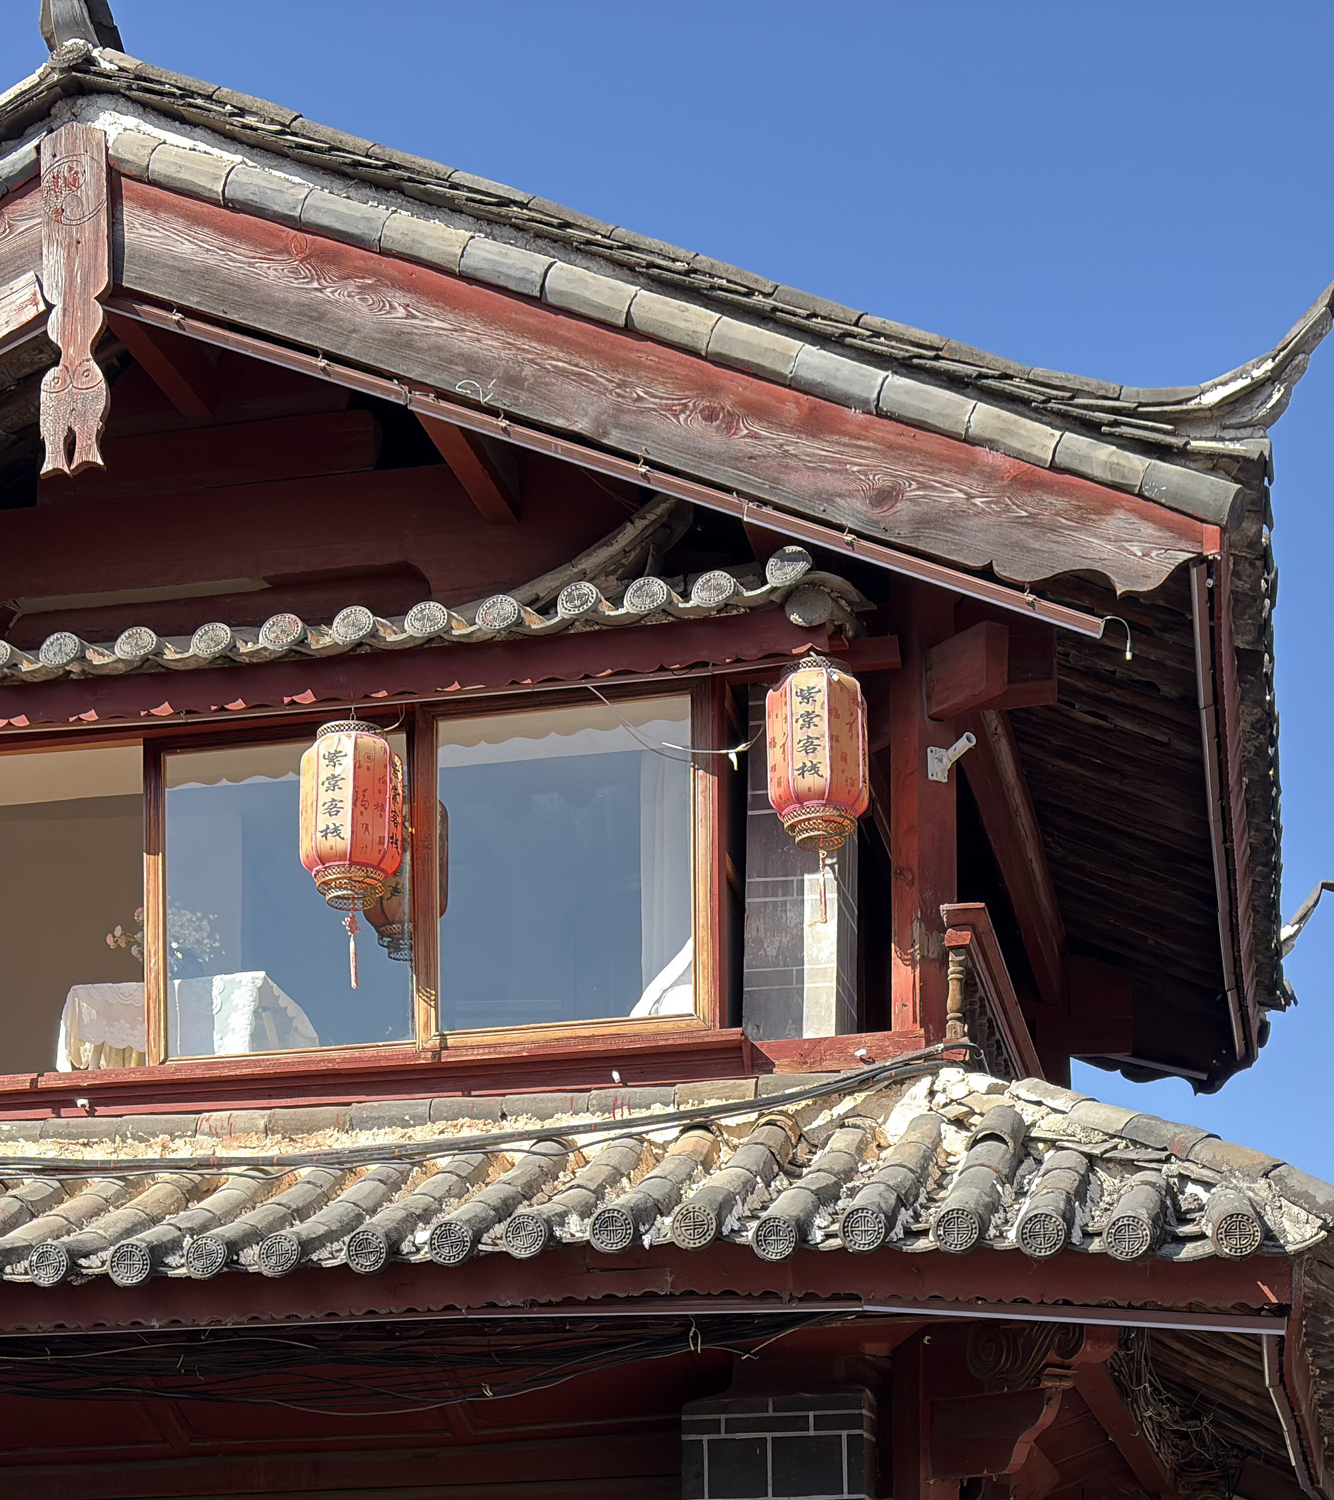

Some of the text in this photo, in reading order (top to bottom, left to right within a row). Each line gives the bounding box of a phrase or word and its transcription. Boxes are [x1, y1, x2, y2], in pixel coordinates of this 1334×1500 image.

[794, 686, 824, 779] 紫棠客栈
[319, 749, 348, 841] 紫棠客栈
